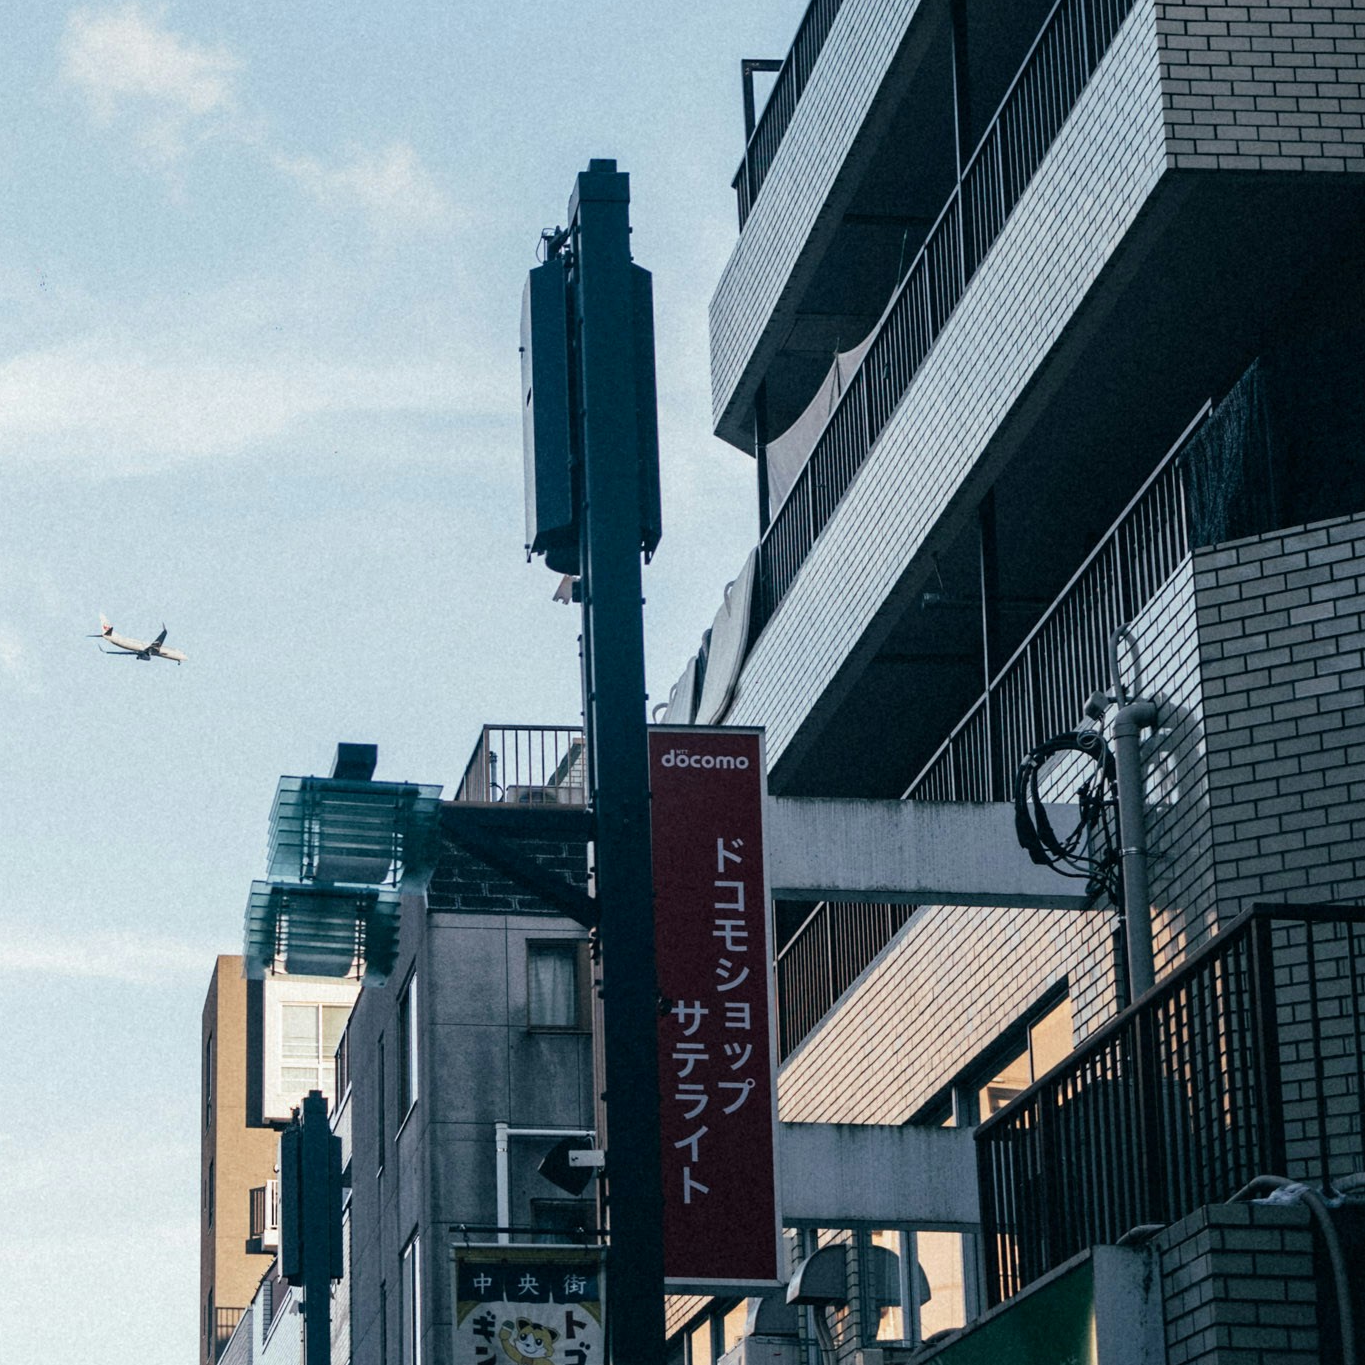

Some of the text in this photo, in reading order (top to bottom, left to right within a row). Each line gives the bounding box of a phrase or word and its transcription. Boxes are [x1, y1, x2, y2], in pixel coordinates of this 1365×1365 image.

[661, 749, 749, 770] docomo
[713, 837, 756, 1116] ドコモショップ
[671, 1000, 710, 1205] サテライト
[472, 1272, 587, 1295] 中央街
